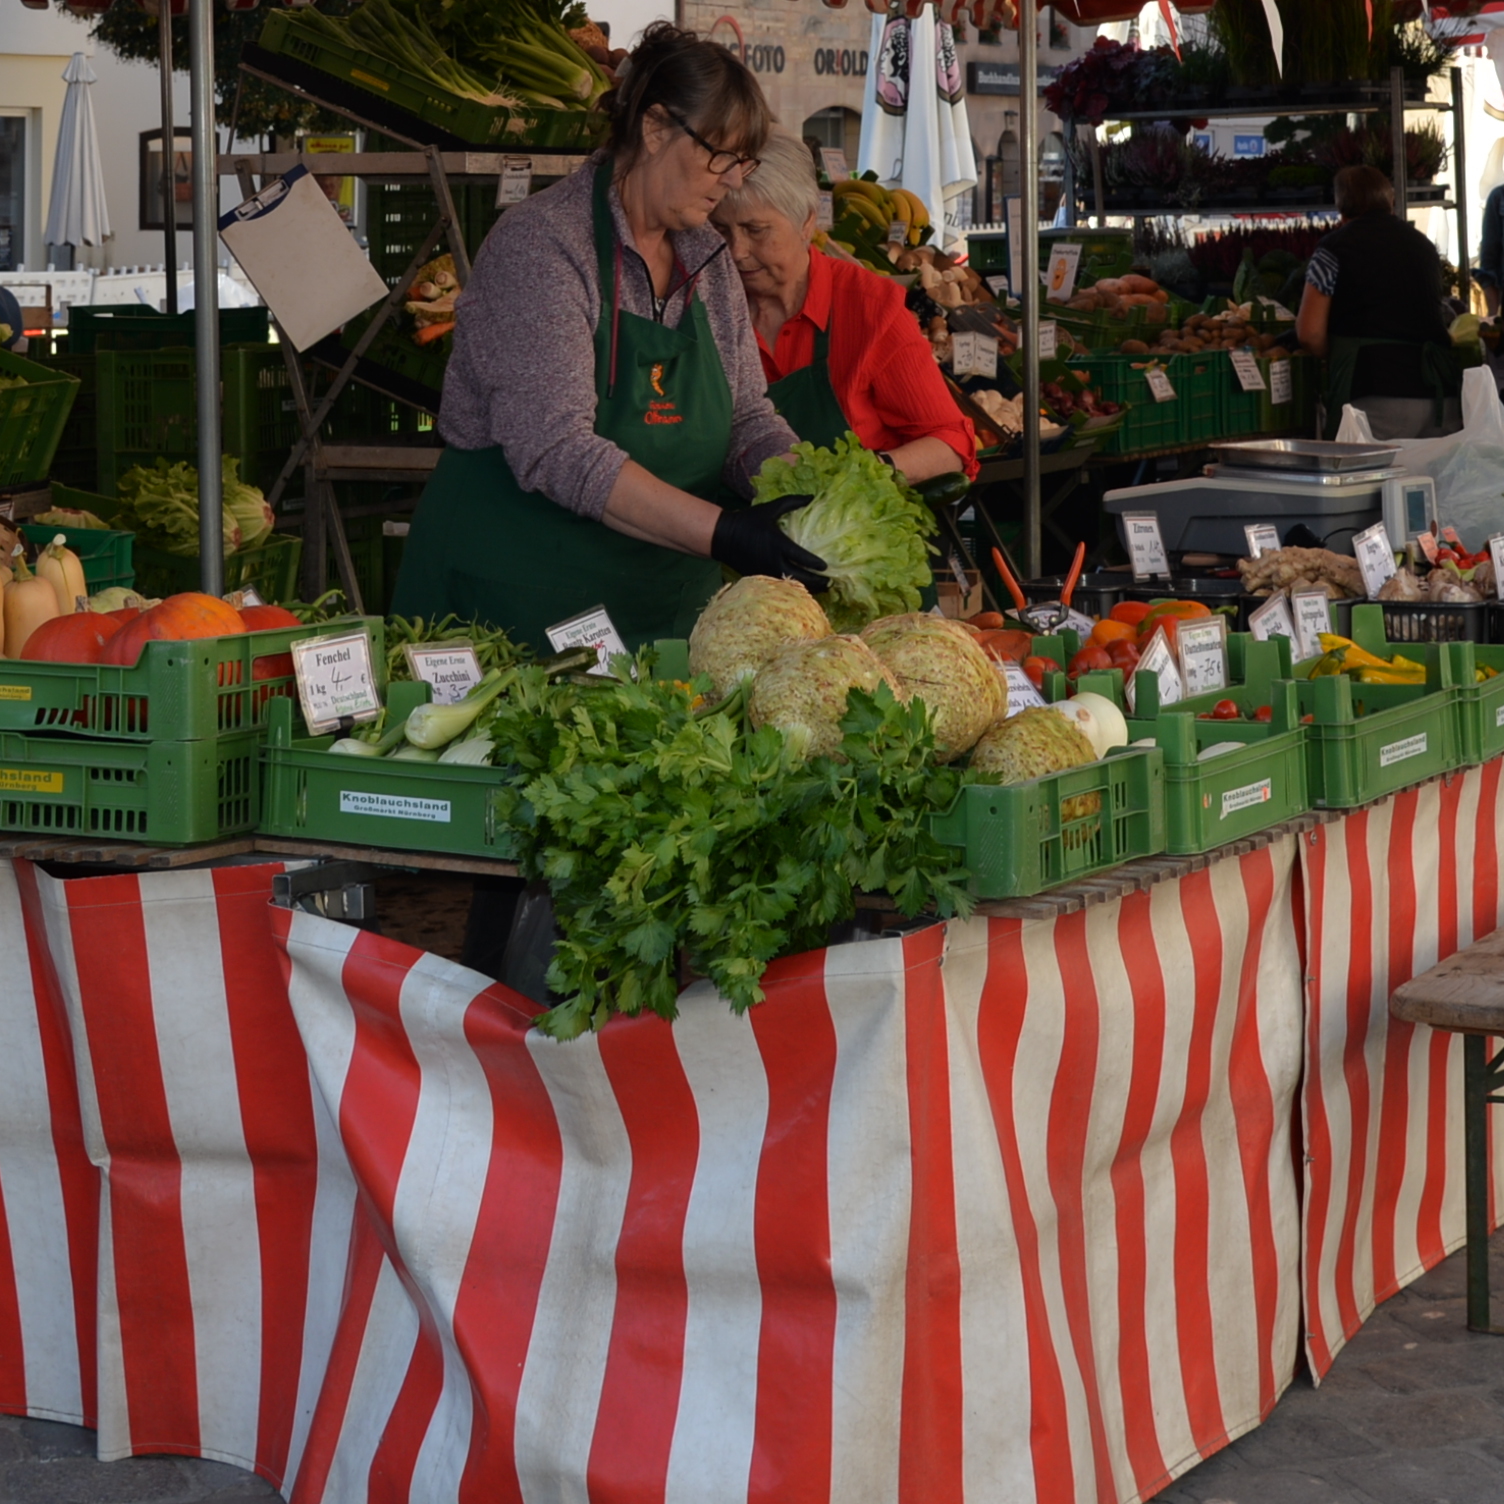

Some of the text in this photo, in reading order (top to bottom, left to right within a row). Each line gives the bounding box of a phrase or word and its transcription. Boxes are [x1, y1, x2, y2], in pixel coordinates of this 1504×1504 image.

[583, 627, 612, 644] Karotten
[316, 648, 351, 666] Fenchel
[425, 656, 466, 668] Eigene Ernte
[316, 684, 327, 695] kg
[360, 674, 366, 684] €
[432, 670, 471, 683] Zucchini
[1381, 736, 1425, 756] Knoblauchsland
[342, 793, 448, 811] Knoblauchsland
[354, 804, 437, 820] Großmarkt Nürnberg
